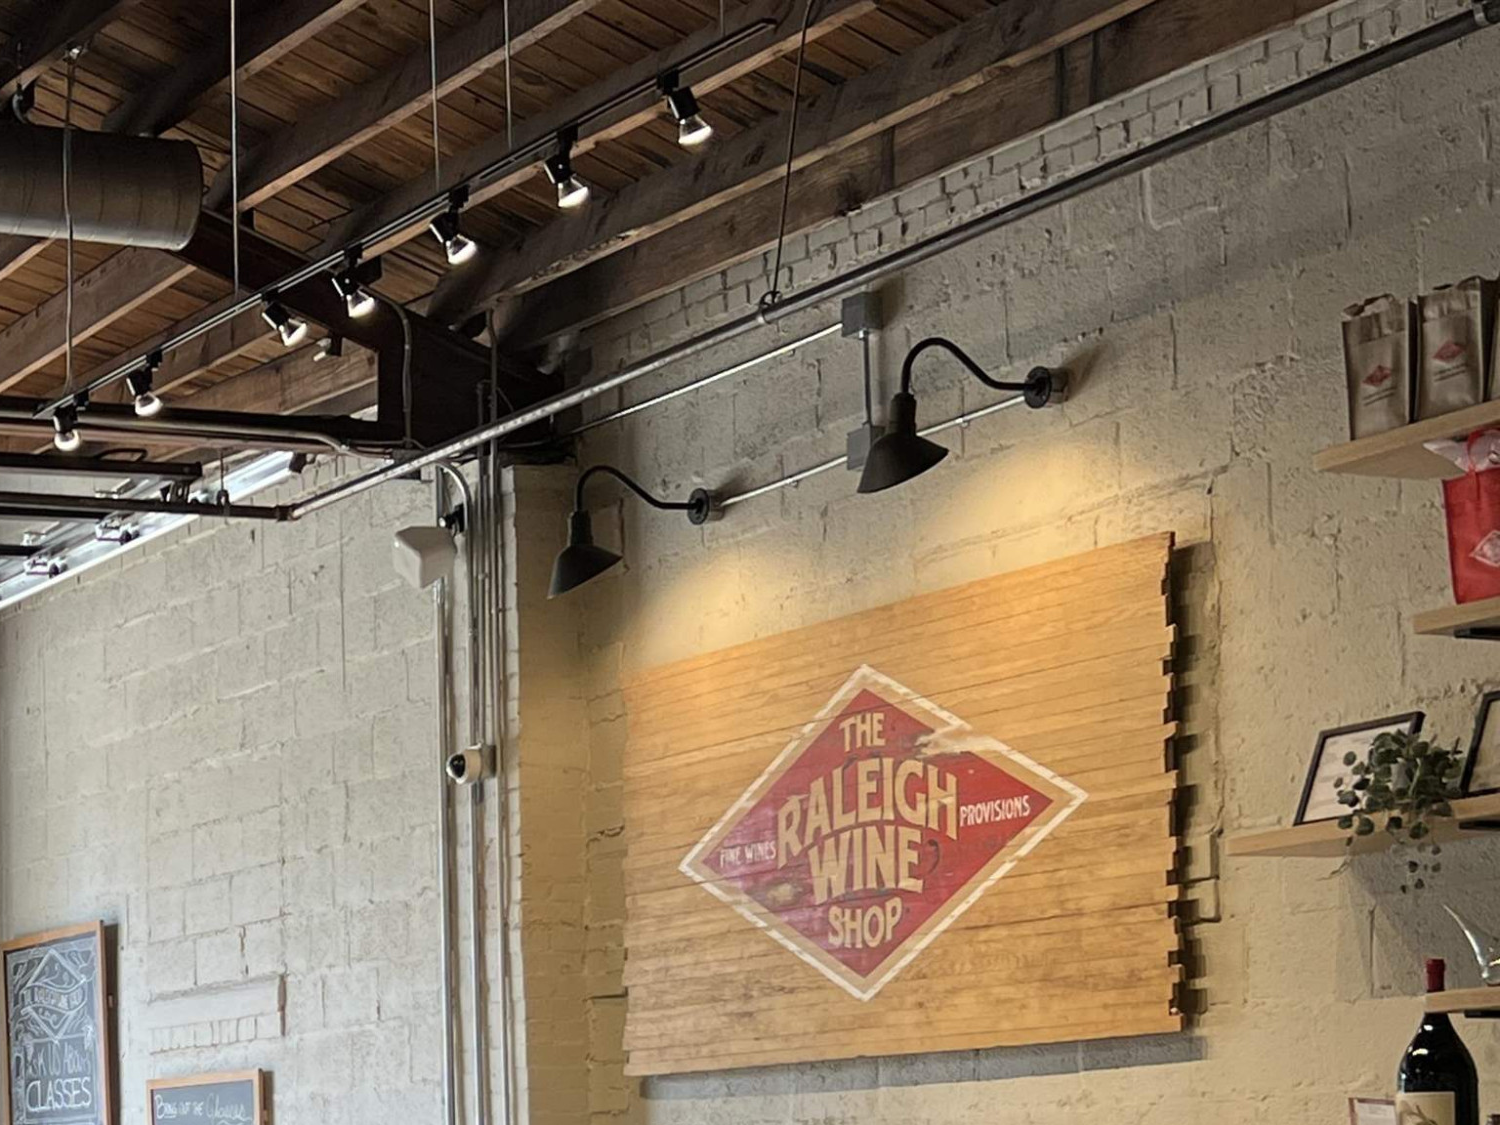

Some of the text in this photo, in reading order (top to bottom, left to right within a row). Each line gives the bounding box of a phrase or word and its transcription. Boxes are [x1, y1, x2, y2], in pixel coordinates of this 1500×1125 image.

[839, 712, 886, 752] THE
[777, 757, 958, 870] RALEIGH
[959, 795, 1031, 827] PROVISIONS
[744, 841, 777, 862] WINES
[808, 825, 923, 905] WINE
[828, 897, 902, 949] SHOP
[25, 1077, 92, 1113] CLASSES
